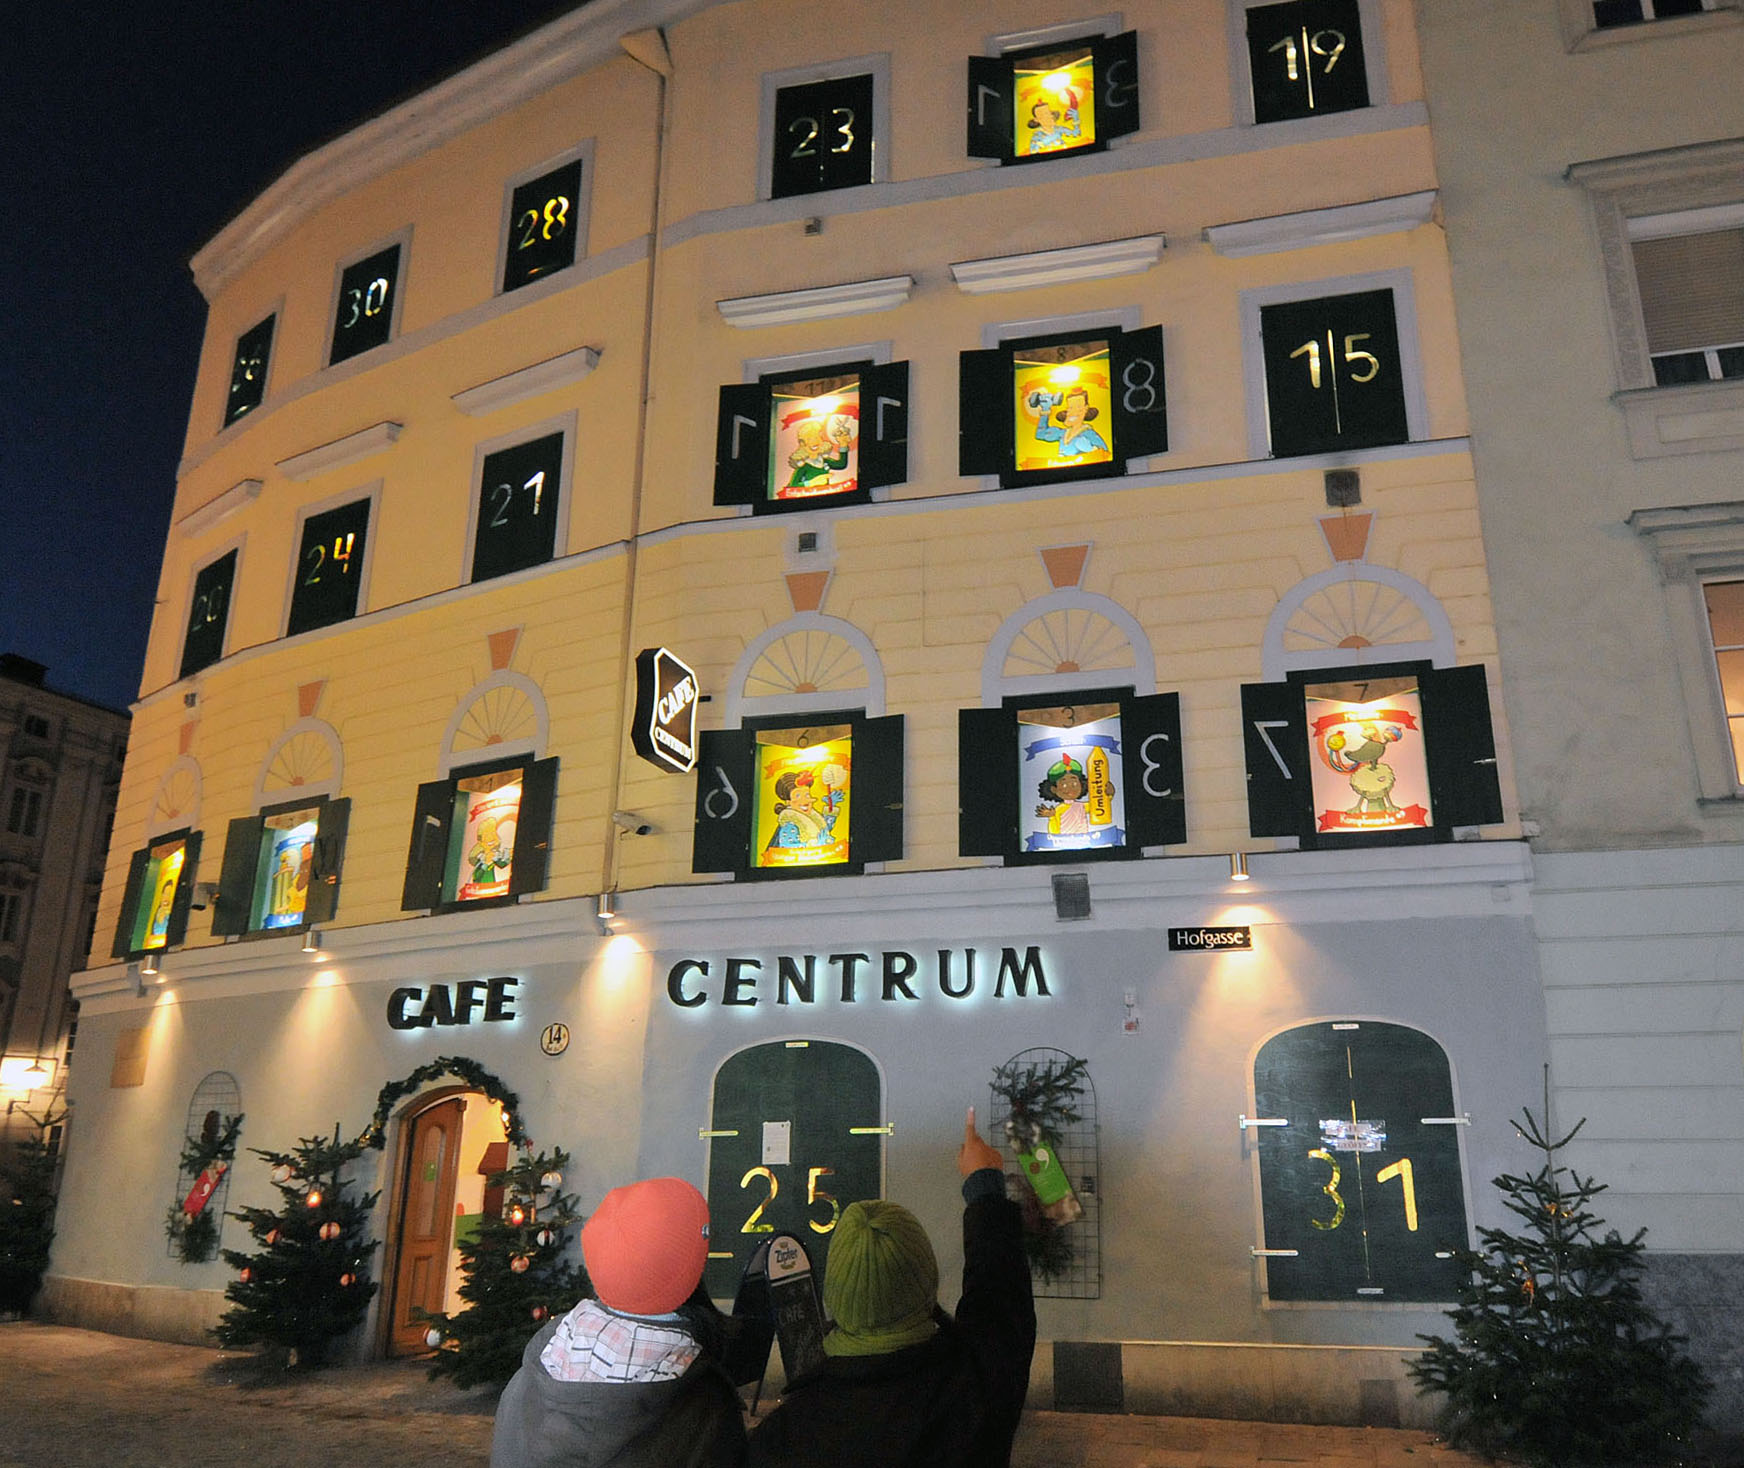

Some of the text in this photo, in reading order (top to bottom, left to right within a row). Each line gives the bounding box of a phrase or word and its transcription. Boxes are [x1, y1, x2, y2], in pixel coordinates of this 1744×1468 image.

[1268, 28, 1346, 81] 19
[788, 107, 854, 160] 23
[516, 196, 569, 250] 28
[344, 278, 389, 328] 30
[1289, 332, 1379, 389] 15
[490, 471, 545, 528] 21
[305, 532, 355, 586] 24
[658, 675, 695, 725] CAFE
[796, 728, 810, 749] 6
[1093, 759, 1105, 817] Umleitung
[1176, 929, 1244, 949] Hofgasse
[386, 976, 520, 1030] CAFE
[667, 945, 1053, 1008] CENTRUM
[548, 1025, 562, 1045] 14
[739, 1165, 841, 1234] 25
[1307, 1148, 1419, 1232] 31
